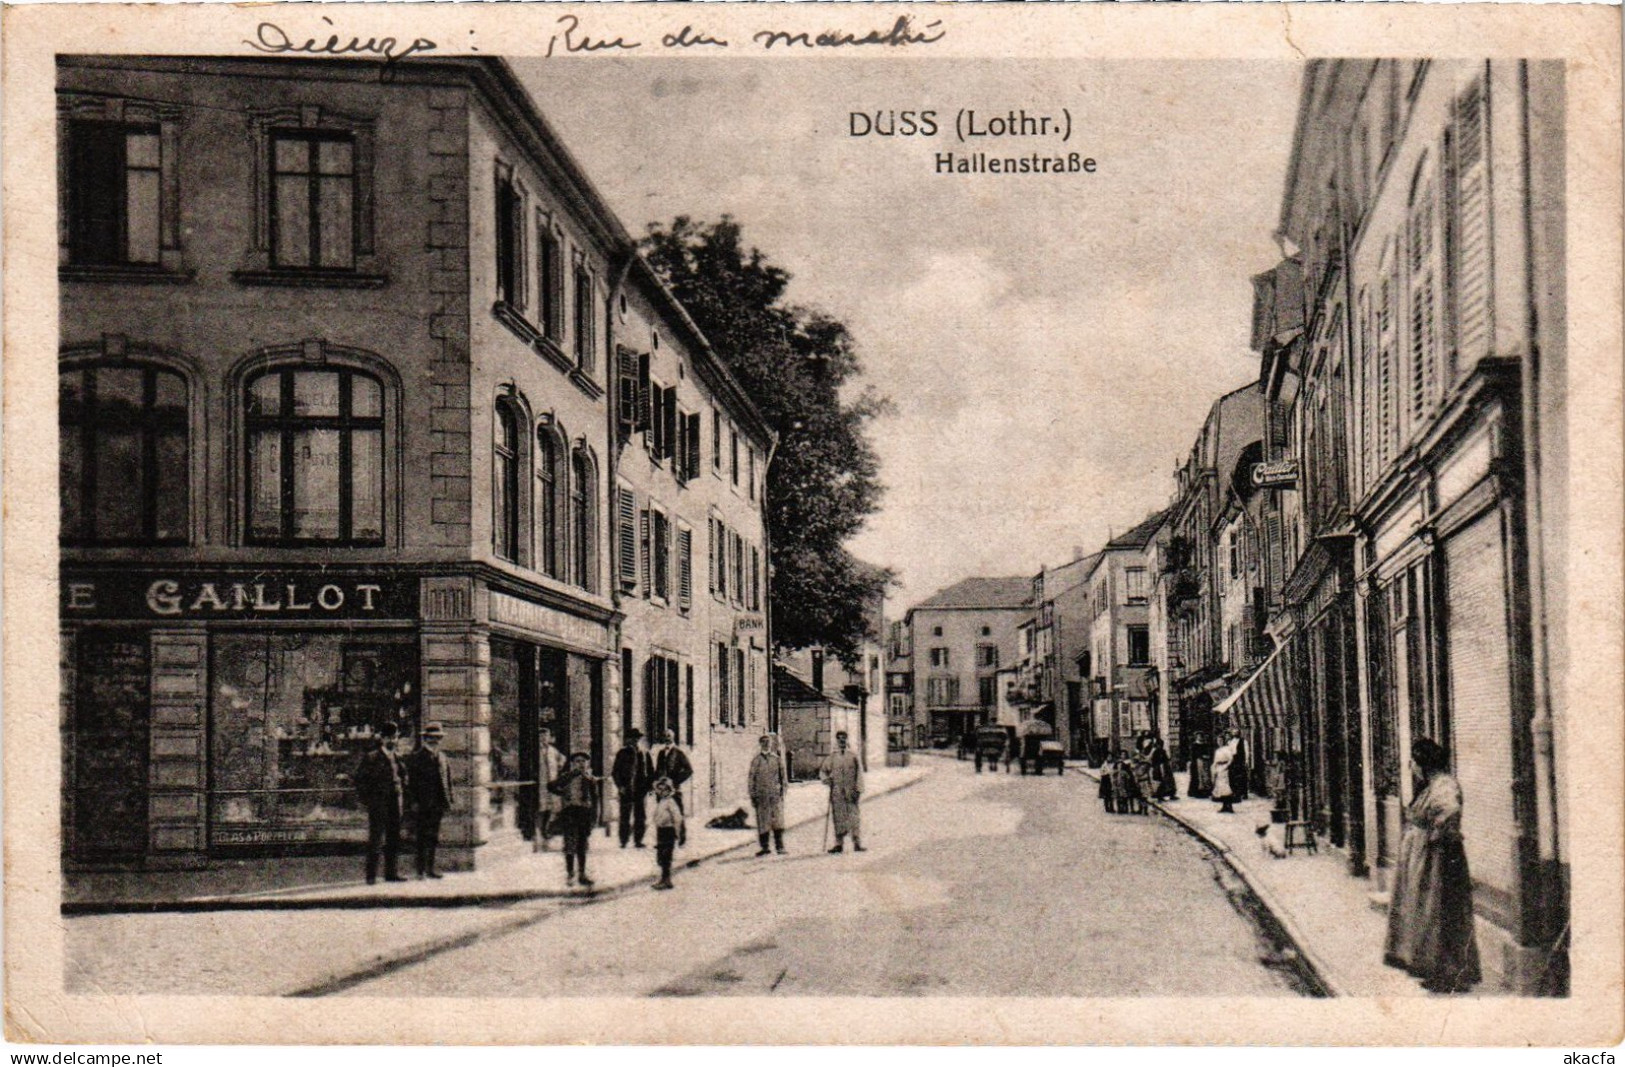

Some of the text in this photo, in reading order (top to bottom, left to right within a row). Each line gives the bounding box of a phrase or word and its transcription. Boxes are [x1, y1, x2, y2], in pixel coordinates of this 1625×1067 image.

[546, 15, 641, 57] Rue
[663, 26, 727, 48] du
[739, 618, 764, 630] BANK
